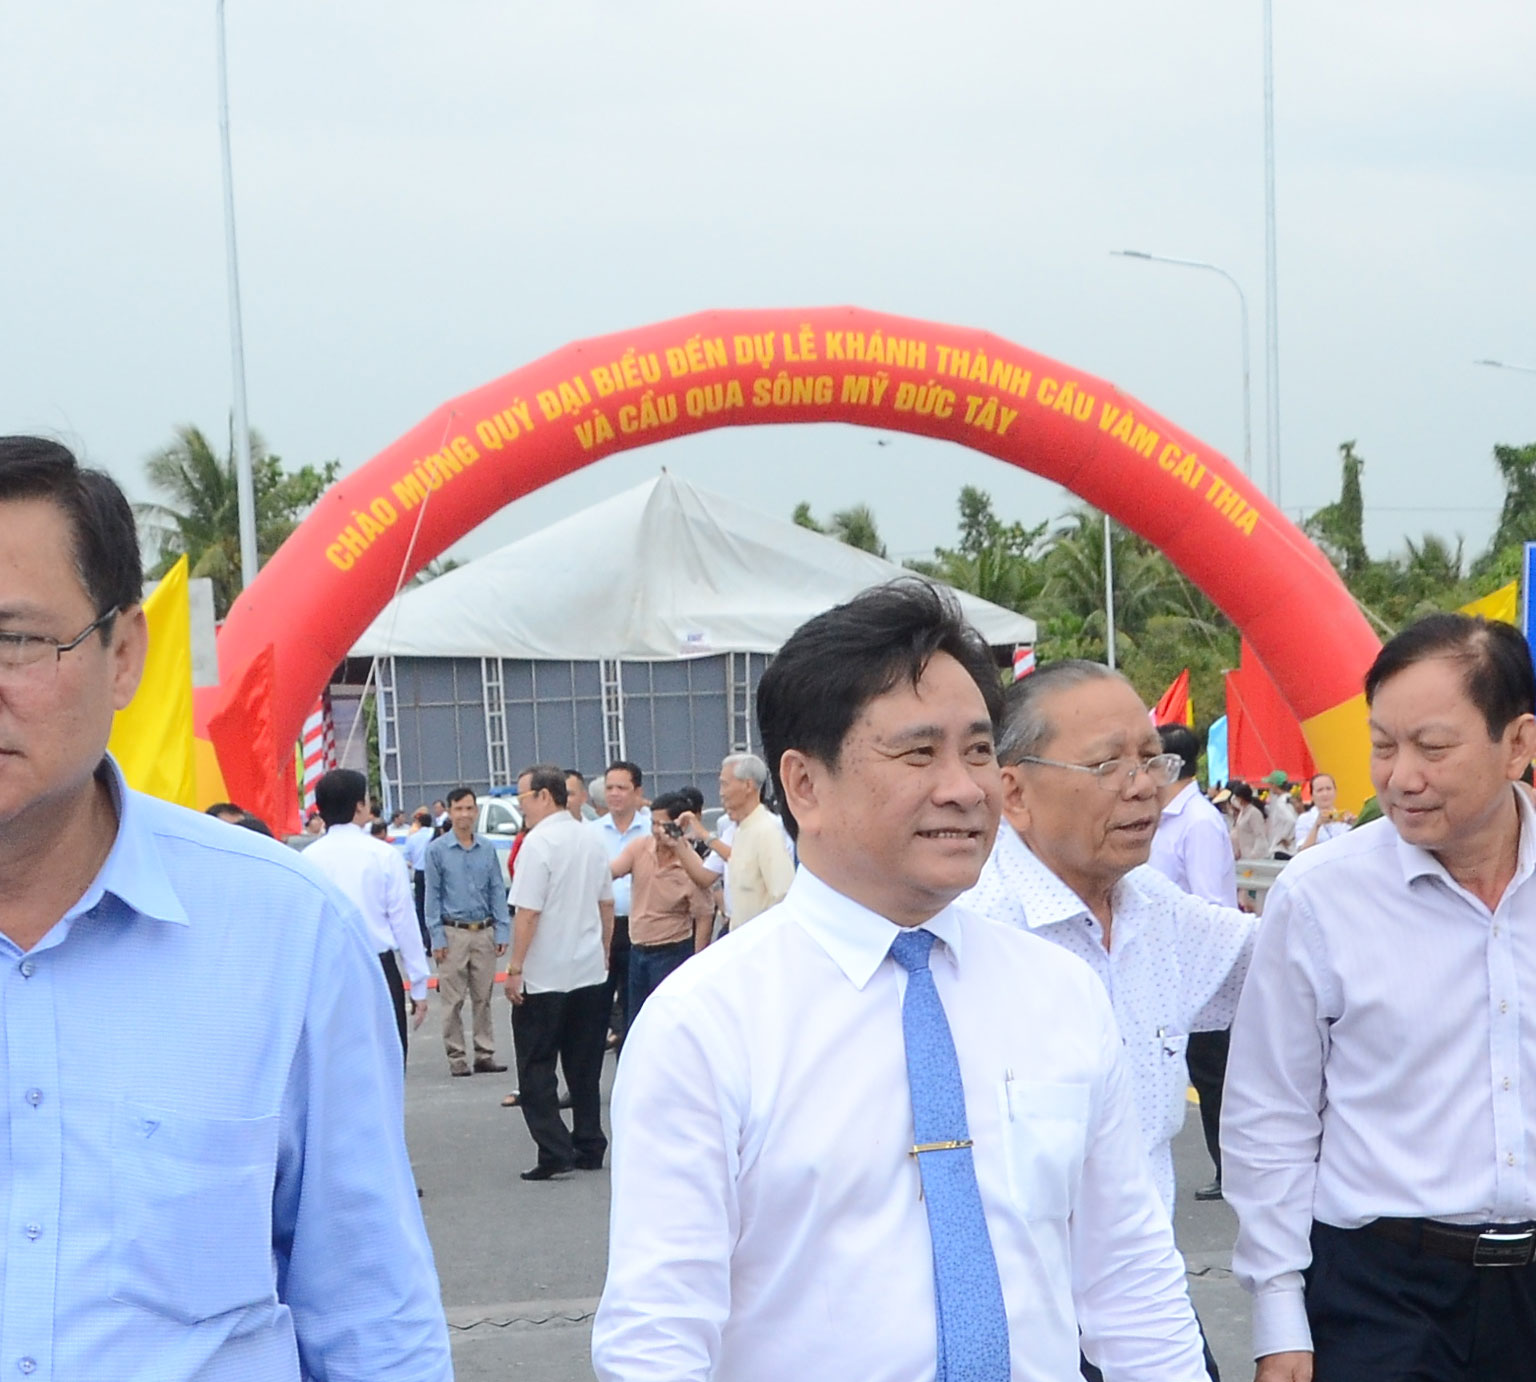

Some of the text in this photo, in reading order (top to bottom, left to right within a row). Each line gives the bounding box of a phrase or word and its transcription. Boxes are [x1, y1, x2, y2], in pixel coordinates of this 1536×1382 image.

[325, 496, 398, 572] CHÀO
[390, 440, 481, 511] MỪNG
[475, 396, 535, 451] QUÝ
[535, 375, 592, 423] ĐẠI
[590, 346, 662, 398] BIỂU
[665, 334, 729, 378] ĐẾN
[732, 331, 776, 369] DỰ
[782, 322, 818, 363] LỄ
[825, 328, 927, 371] KHÁNH
[935, 347, 1033, 398] THÀNH
[1097, 401, 1161, 459] VÀM
[1158, 442, 1207, 490] CÁI
[1205, 474, 1261, 536] THIA
[574, 407, 615, 449] VÀ
[685, 379, 745, 418] QUA
[752, 370, 834, 406] SÔNG
[840, 370, 889, 407] MỸ
[893, 378, 956, 419] ĐỨC
[964, 396, 1019, 436] TÂY
